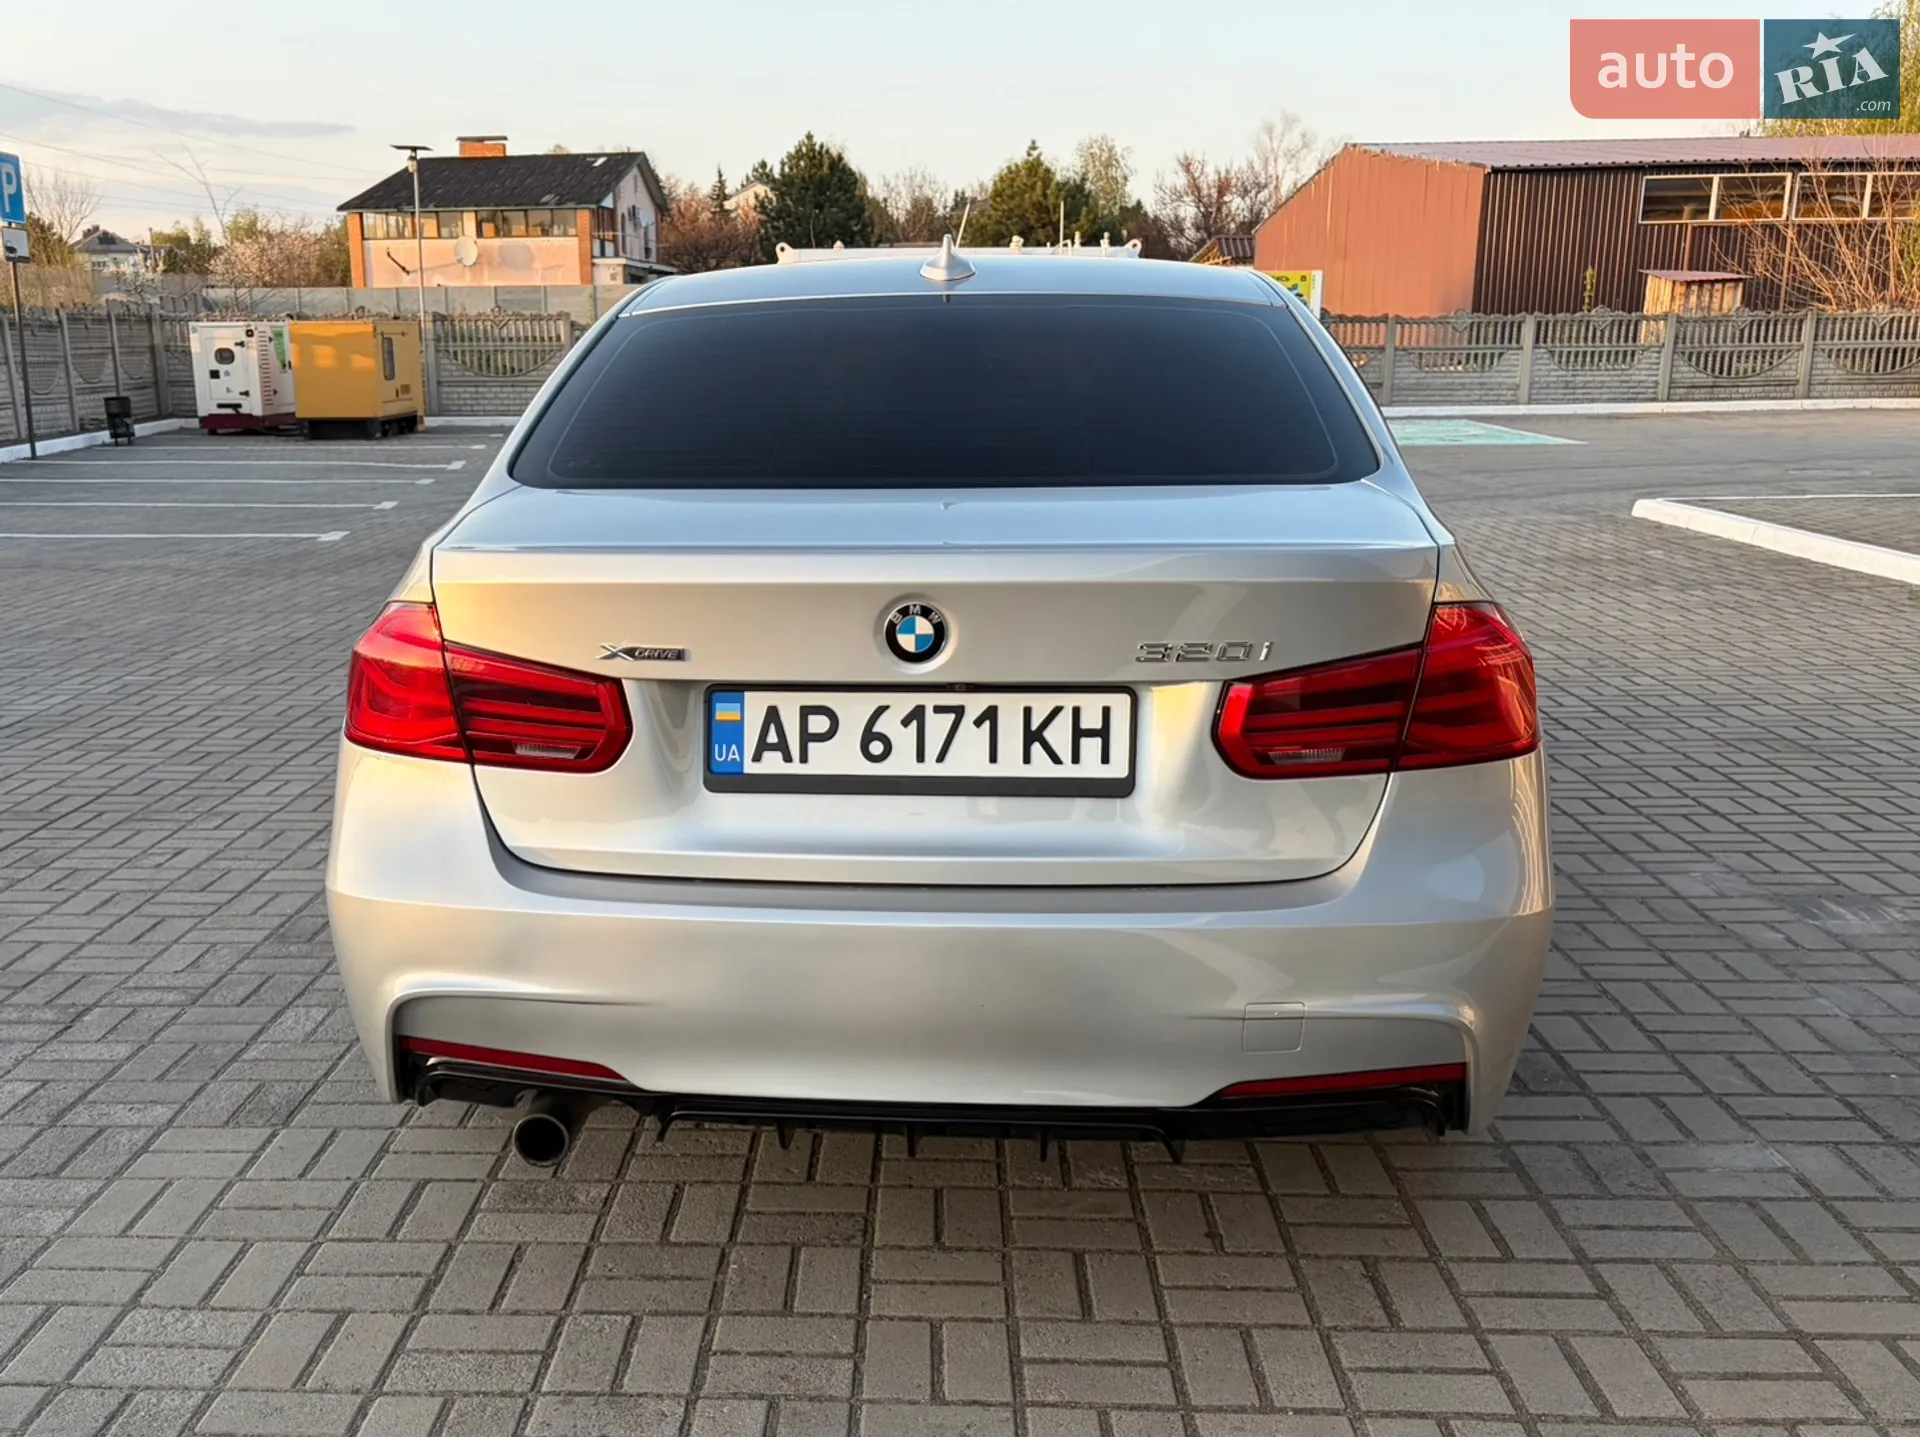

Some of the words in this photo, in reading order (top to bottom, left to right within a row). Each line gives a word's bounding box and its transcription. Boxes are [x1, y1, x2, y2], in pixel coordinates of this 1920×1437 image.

[1, 162, 18, 213] P
[890, 604, 941, 624] BMW
[1135, 641, 1274, 662] 320i
[751, 705, 839, 764] AP
[859, 704, 998, 764] 6171
[1022, 705, 1111, 765] KH
[714, 743, 741, 762] UA
